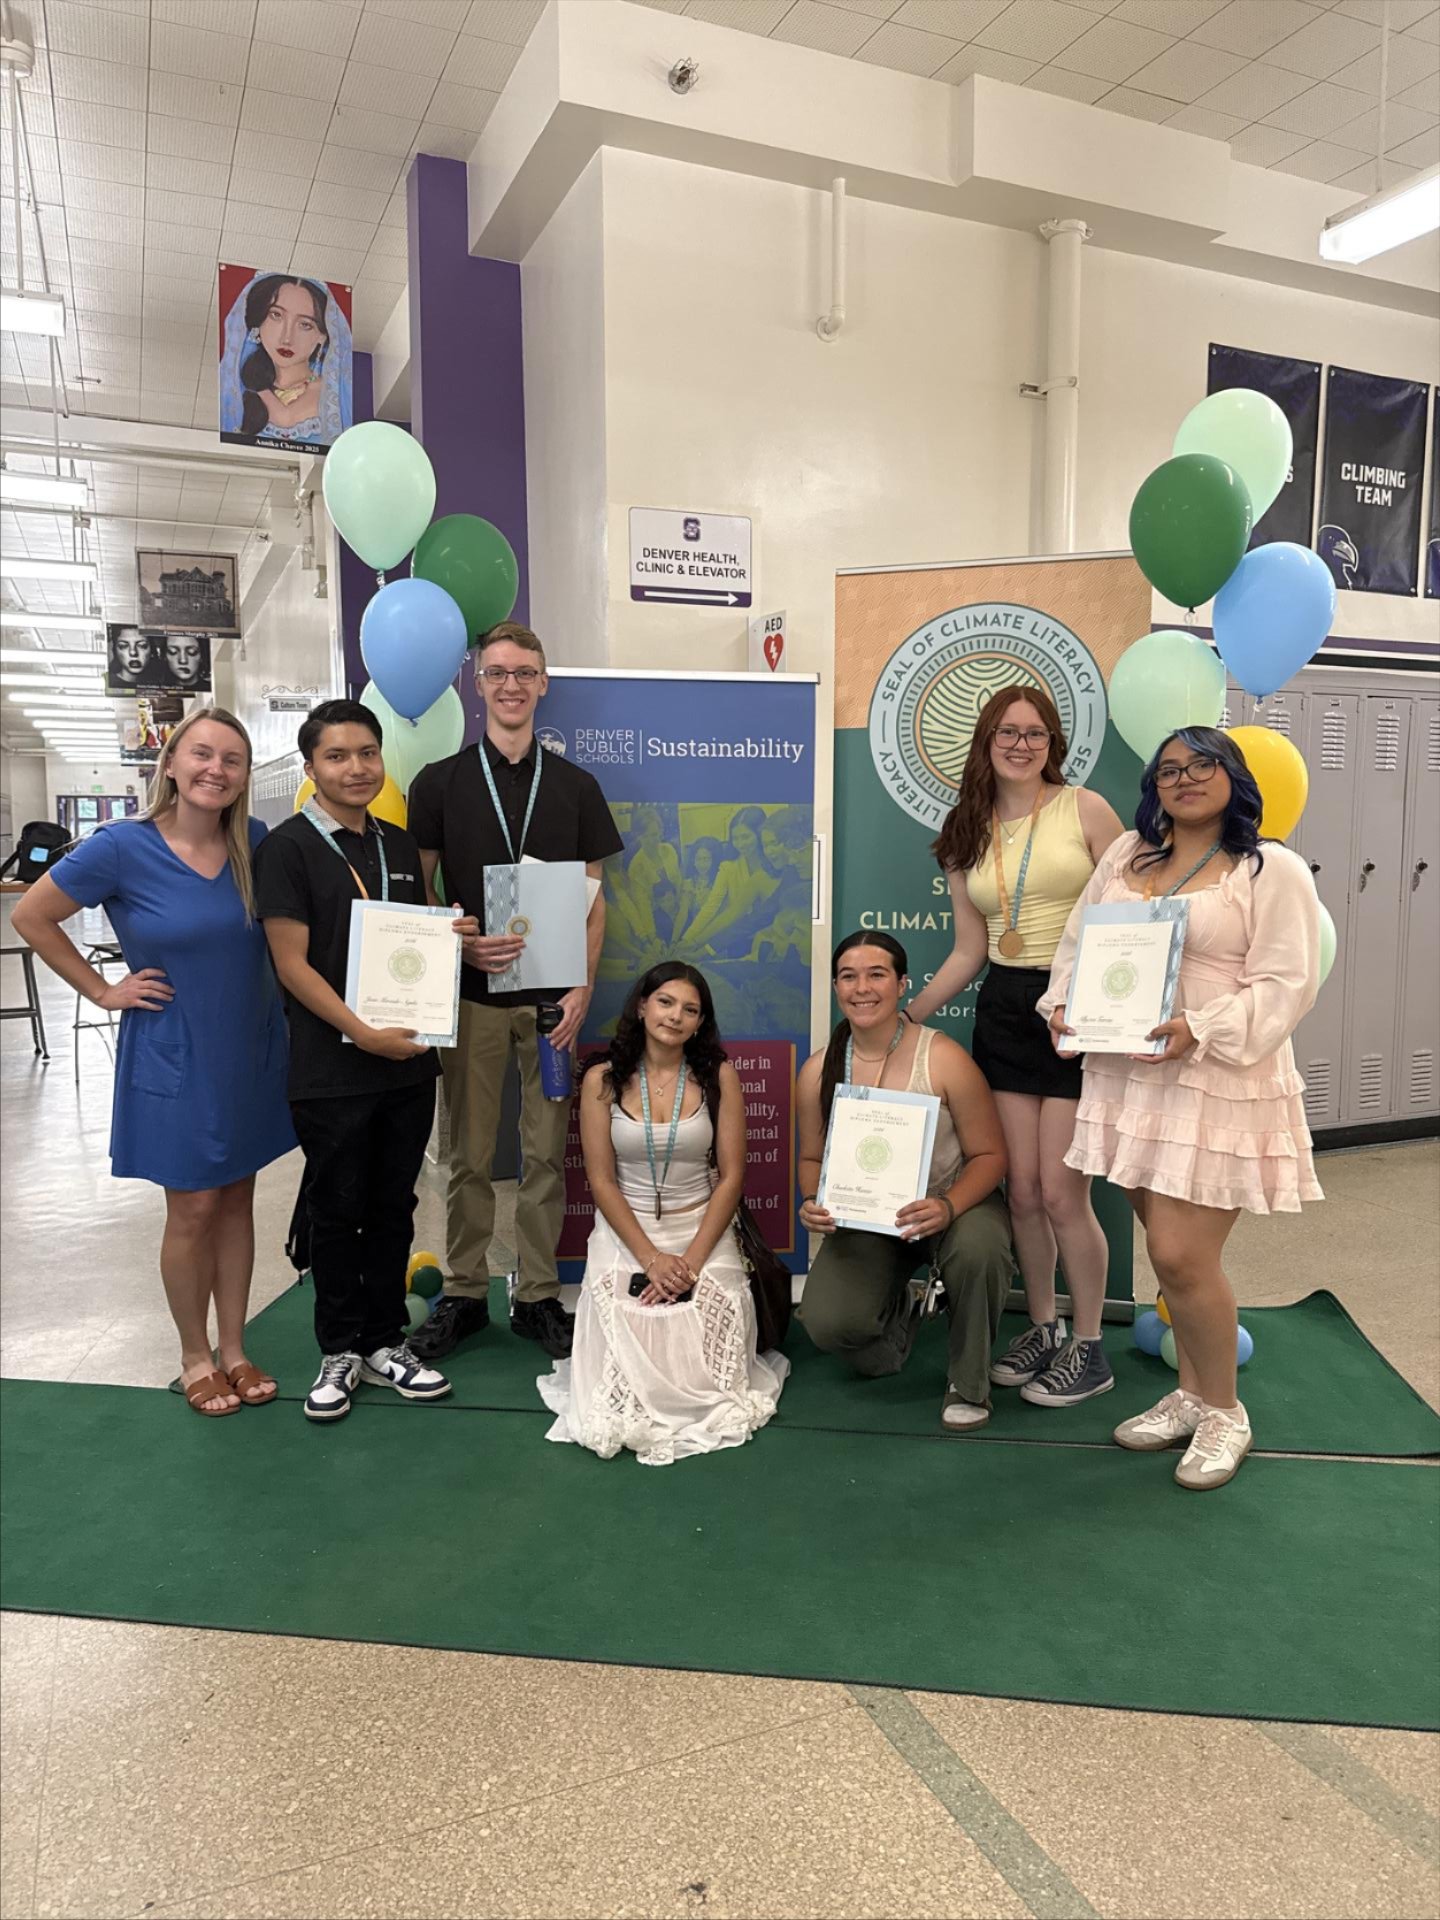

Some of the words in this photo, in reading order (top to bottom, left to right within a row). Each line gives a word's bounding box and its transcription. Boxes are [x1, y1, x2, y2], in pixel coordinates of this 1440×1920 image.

[1340, 462, 1407, 489] CLIMBING
[1355, 485, 1393, 507] TEAM
[642, 547, 690, 562] DENVER
[635, 561, 675, 575] CLINIC
[677, 565, 686, 575] &
[688, 565, 747, 580] ELEVATOR
[764, 616, 783, 633] AED
[882, 659, 914, 702] SEAL
[912, 632, 936, 656] OF
[940, 612, 1026, 638] CLIMATE
[1029, 621, 1096, 696] LITERACY
[575, 728, 635, 741] DENVER
[575, 741, 635, 754] PUBLIC
[647, 737, 805, 763] Sustainability
[575, 753, 635, 764] SCHOOLS
[1063, 744, 1092, 786] SEA
[879, 750, 942, 823] LITERACY
[859, 911, 953, 930] CLIMAT
[758, 1056, 771, 1070] in
[765, 1148, 778, 1163] of
[766, 1195, 779, 1210] of
